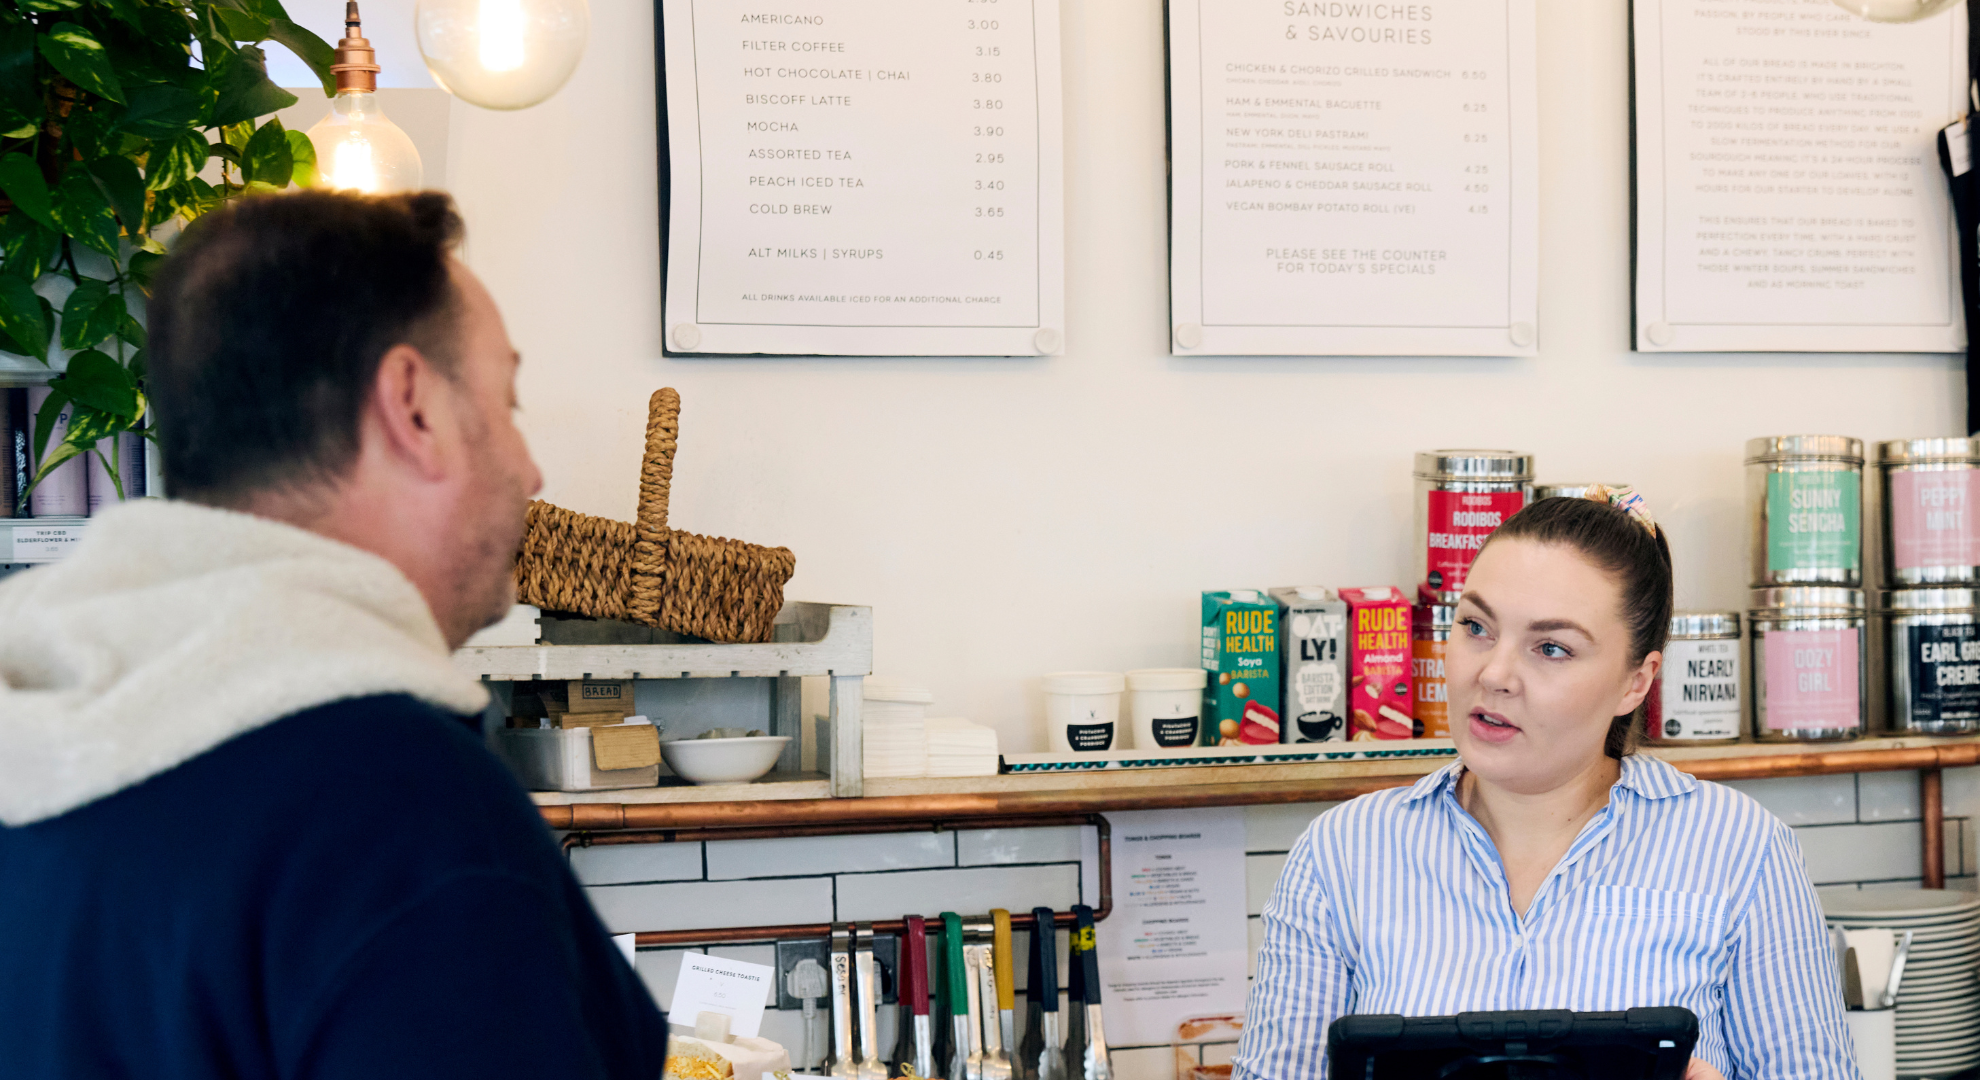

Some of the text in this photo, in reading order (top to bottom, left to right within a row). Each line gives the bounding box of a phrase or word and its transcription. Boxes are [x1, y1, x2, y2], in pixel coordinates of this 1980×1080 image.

[1284, 1, 1432, 21] SANDWICHES
[741, 14, 999, 30] AMERICANO 3.00
[1286, 24, 1431, 45] & SAVOURIES
[742, 40, 1000, 56] FILTER COFFEE 3.15
[744, 68, 771, 77] HOT
[778, 68, 862, 79] CHOCOLATE
[877, 70, 909, 80] CHAI
[972, 72, 1002, 83] 3.80
[1226, 63, 1276, 73] CHICKEN
[1280, 64, 1286, 74] &
[1290, 65, 1340, 75] CHORIZO
[1392, 68, 1451, 79] SANDWICH
[746, 94, 1003, 110] BISCOFF LATTE 3.80
[1226, 96, 1250, 106] HAM
[1254, 98, 1261, 106] &
[1265, 98, 1321, 108] EMMENTAL
[1326, 100, 1381, 110] BAGUETTE
[748, 122, 1004, 136] MOCHA 3.90
[1226, 128, 1251, 136] NEW
[1255, 128, 1284, 137] YORK
[1288, 129, 1312, 138] DELI
[1316, 130, 1368, 139] PASTRAMI
[749, 149, 1004, 163] ASSORTED TEA 2.95
[1225, 159, 1254, 169] PORK
[1258, 160, 1265, 169] &
[1269, 160, 1310, 170] FENNEL
[1314, 162, 1364, 171] SAUSAGE
[1368, 163, 1394, 172] ROLL
[750, 176, 1004, 190] PEACH ICED TEA 3.40
[1285, 180, 1292, 189] &
[1296, 180, 1348, 190] CHEDDAR
[1352, 181, 1402, 191] SAUSAGE
[1406, 182, 1432, 192] ROLL
[750, 204, 1004, 217] COLD BREW 3.65
[1226, 201, 1264, 210] VEGAN
[1268, 202, 1313, 211] BOMBAY
[1317, 203, 1359, 212] POTATO
[1363, 204, 1389, 213] ROLL
[748, 248, 772, 258] ALT
[777, 248, 817, 258] MILKS
[832, 249, 883, 259] SYRUPS
[974, 250, 1003, 260] 0.45
[1266, 248, 1446, 260] PLEASE SEE THE COUNTER
[1277, 262, 1435, 274] FOR TODAY'S SPECIALS
[1792, 489, 1842, 508] SUNNY
[1921, 487, 1966, 507] PEPPY
[1453, 512, 1502, 527] ROOIBOS
[1788, 513, 1846, 533] SENCHA
[1926, 510, 1964, 530] MINT
[1226, 610, 1274, 634] RUDE
[1358, 606, 1407, 632] RUDE
[1226, 636, 1274, 653] HEALTH
[1358, 632, 1408, 650] HEALTH
[1300, 638, 1337, 661] LY!
[1920, 642, 1960, 662] EARL
[1237, 656, 1263, 668] Soya
[1364, 653, 1404, 663] Almond
[1794, 648, 1834, 668] DOZY
[1231, 669, 1269, 679] BARISTA
[1364, 666, 1403, 676] BARISTA
[1412, 658, 1445, 678] STRA
[1687, 659, 1735, 678] NEARLY
[1936, 666, 1980, 686] CREME
[1798, 672, 1832, 692] GIRL
[585, 687, 618, 696] BREAD
[1418, 682, 1447, 702] LEM
[692, 965, 760, 982] GRILLED CHEESE TOASTIE
